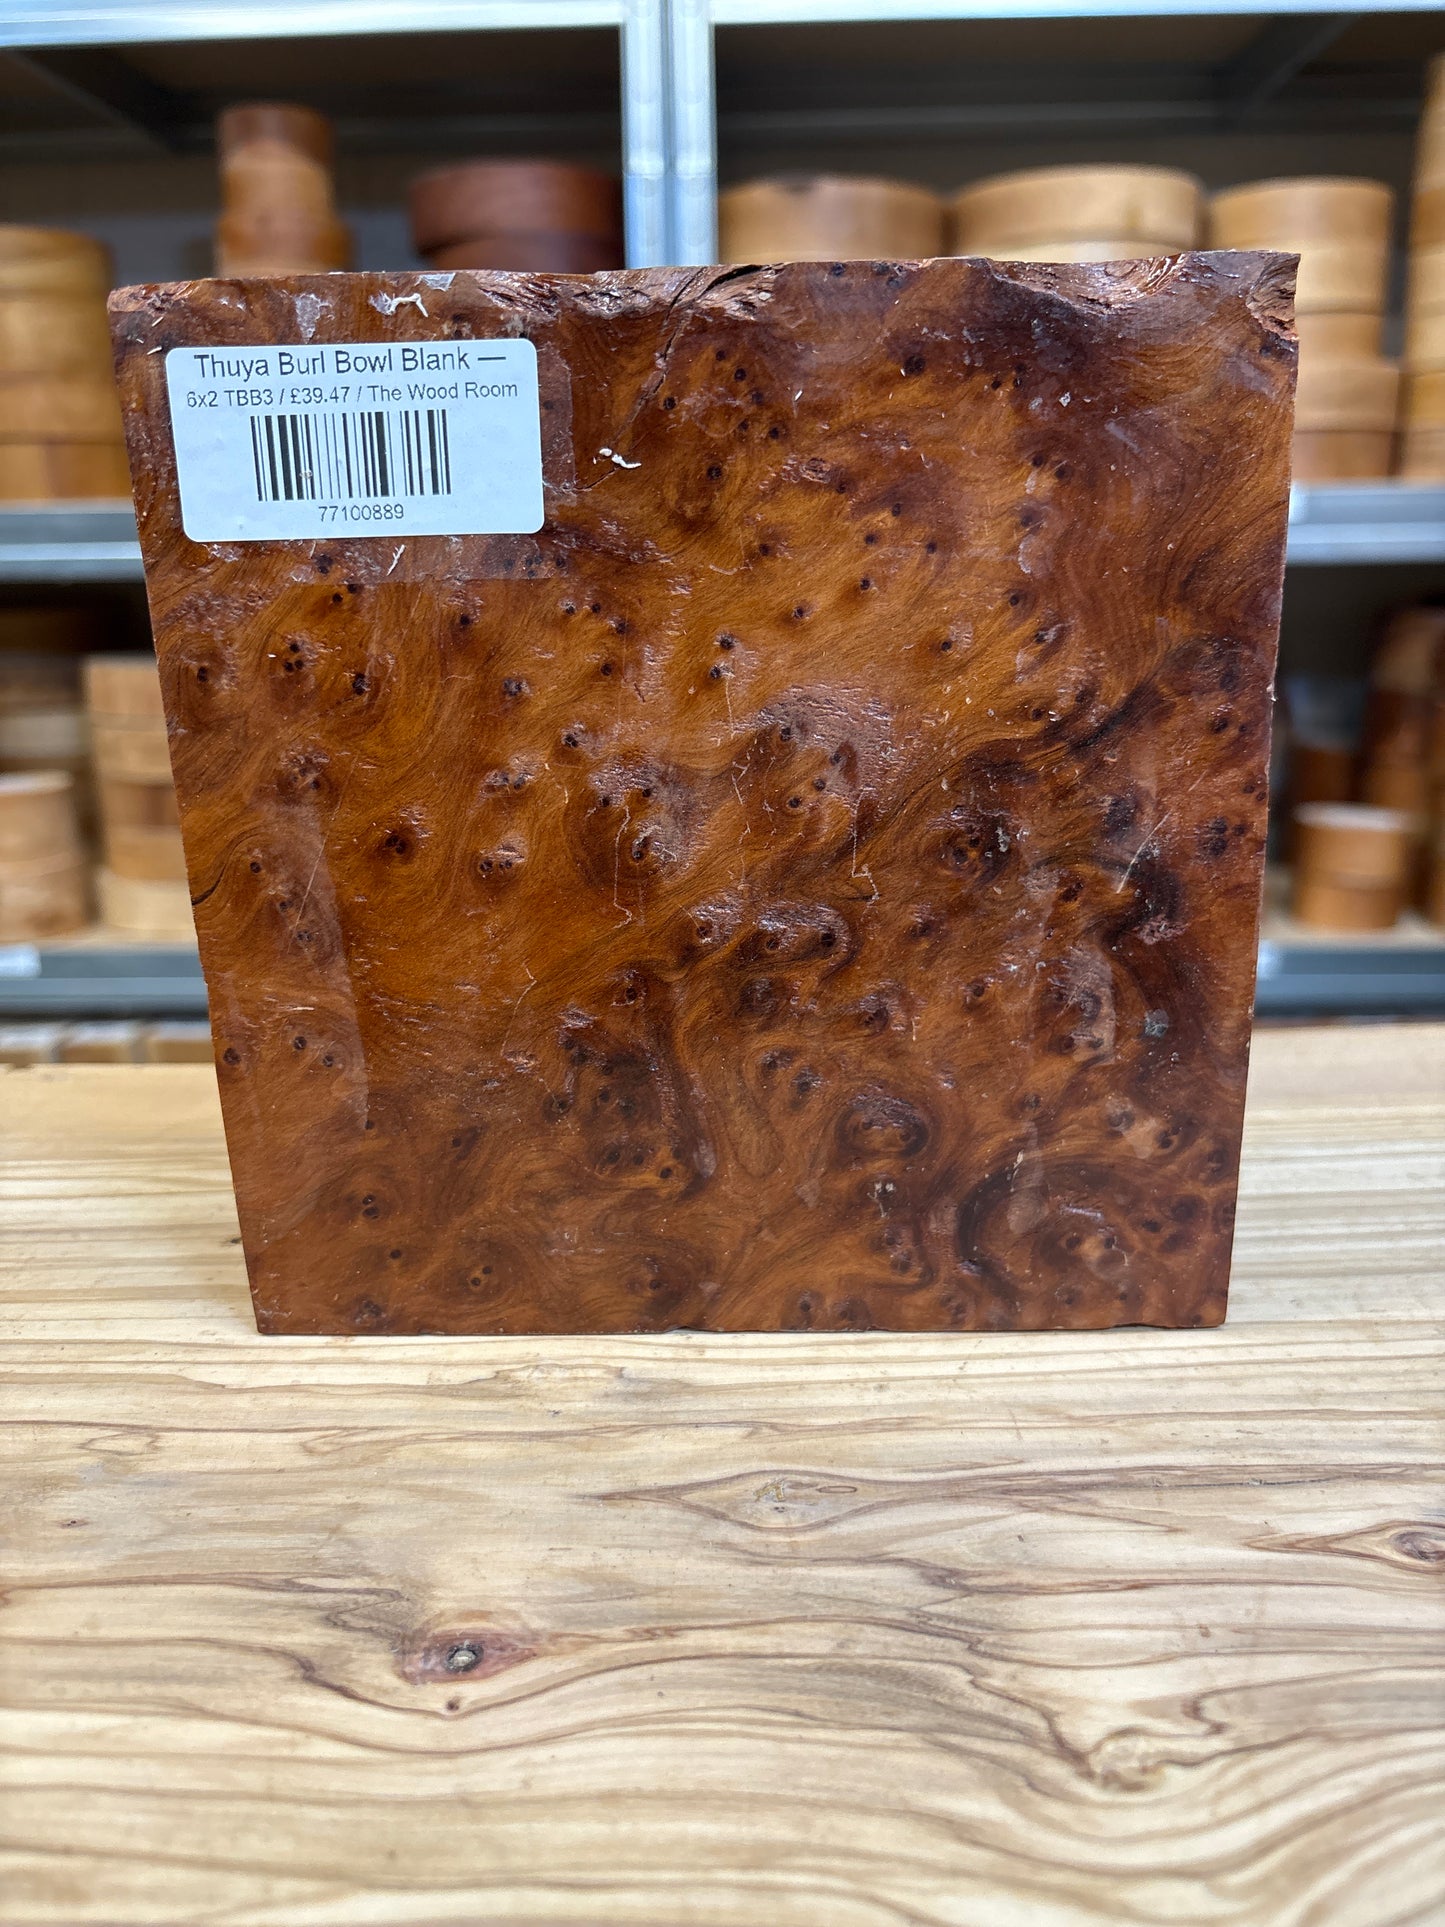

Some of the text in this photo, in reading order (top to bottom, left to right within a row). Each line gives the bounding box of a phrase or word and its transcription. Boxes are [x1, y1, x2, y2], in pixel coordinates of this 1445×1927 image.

[193, 353, 271, 383] Thuya
[277, 350, 326, 376] Burl
[334, 348, 393, 374] Bowl
[400, 345, 471, 372] Blank
[186, 390, 219, 408] 6x2
[223, 388, 274, 407] TBB3
[289, 385, 351, 405] £39.47
[365, 384, 403, 403] The
[406, 382, 459, 401] Wood
[464, 381, 518, 400] Room
[318, 503, 405, 523] 77100889
